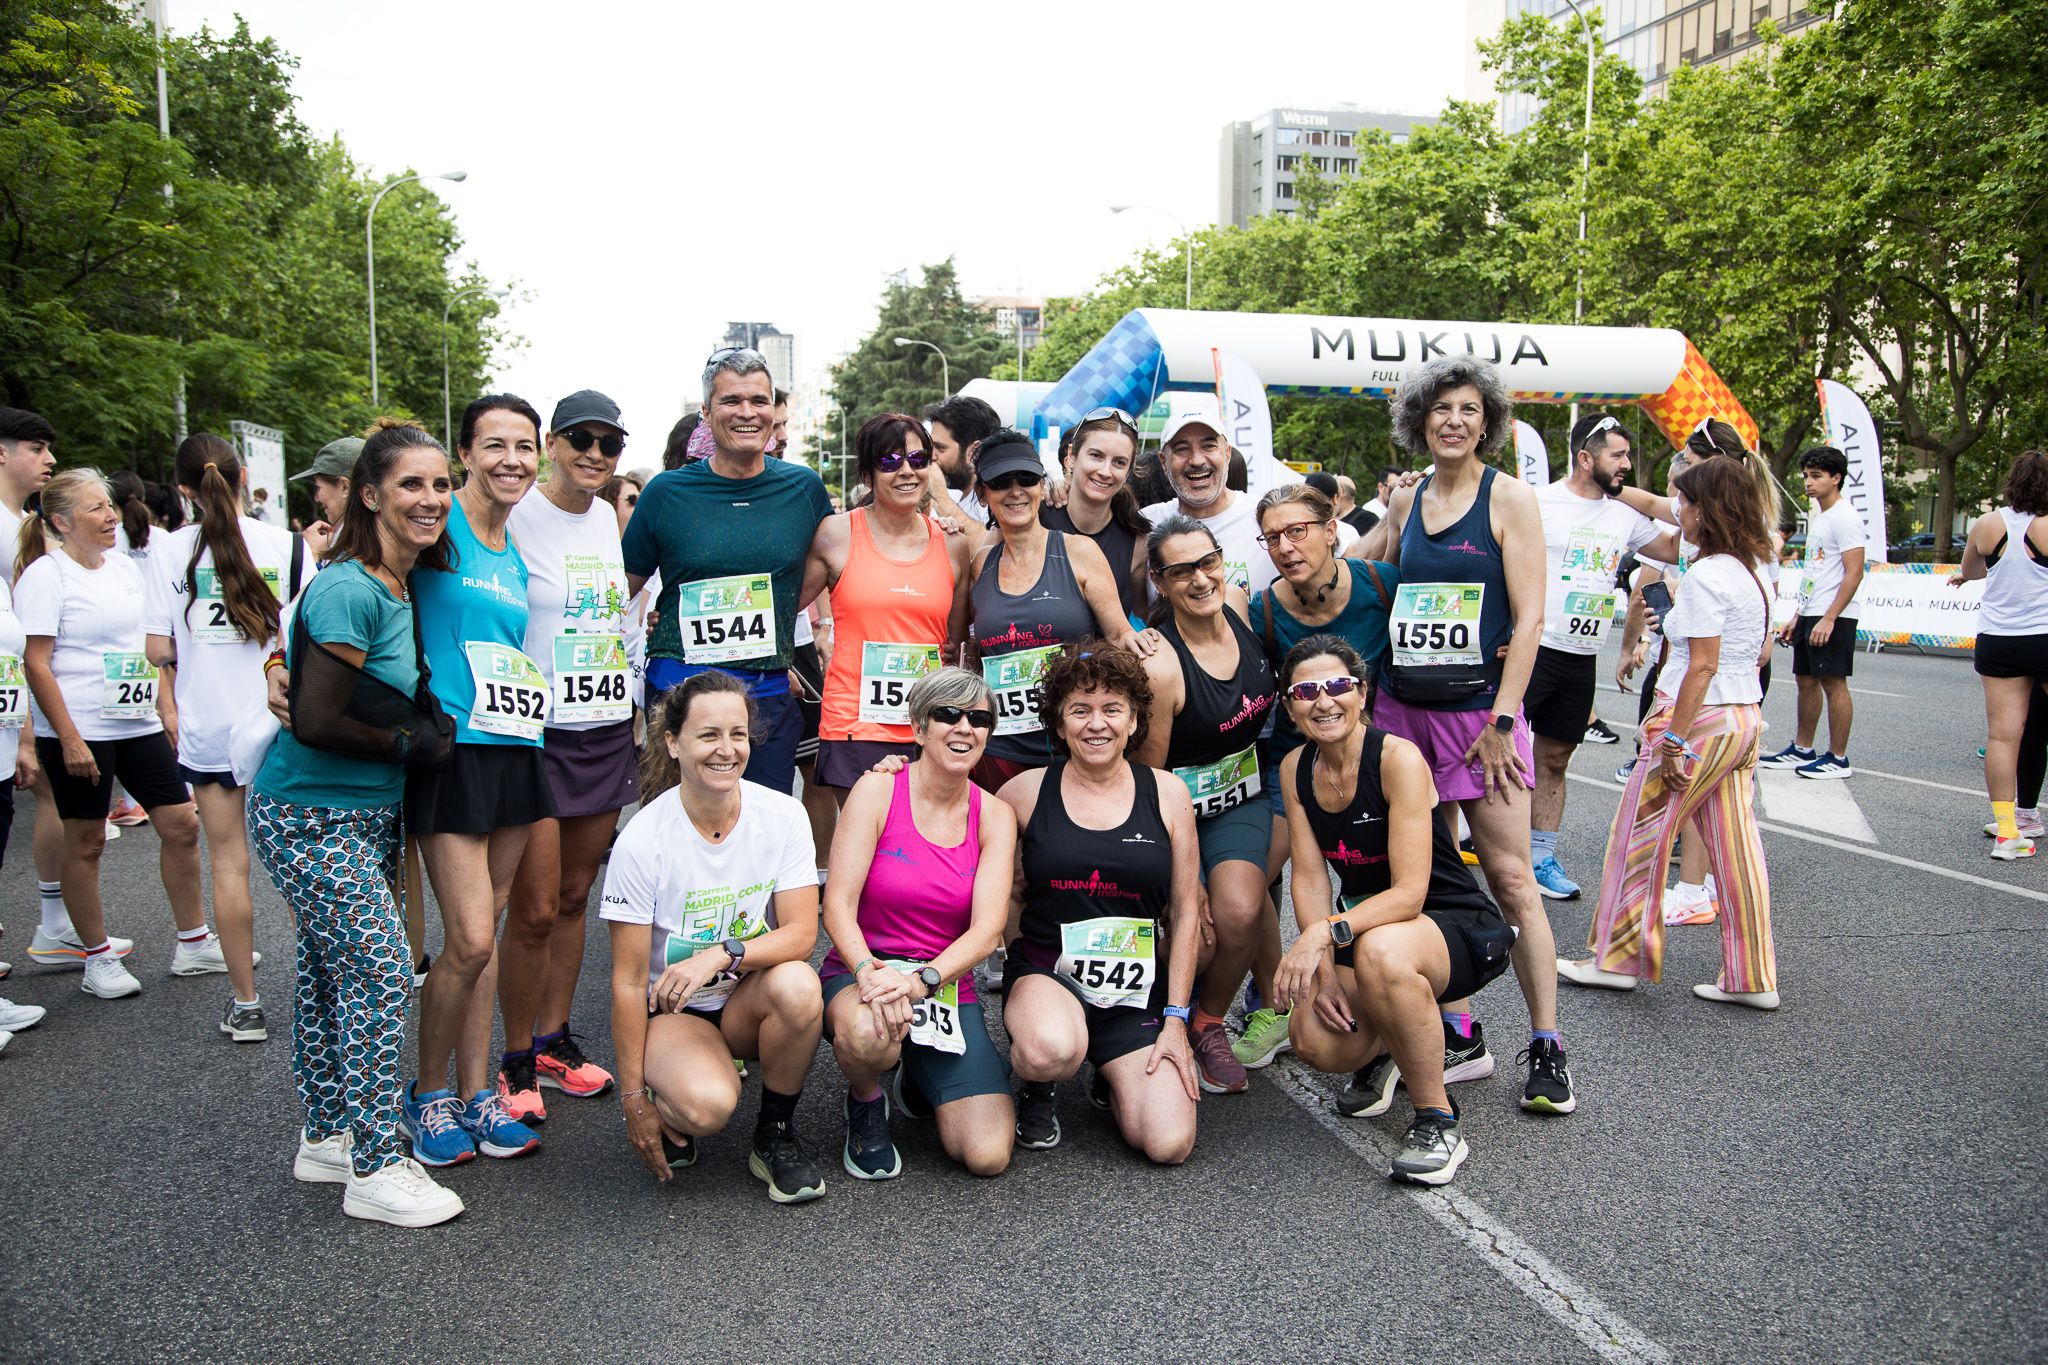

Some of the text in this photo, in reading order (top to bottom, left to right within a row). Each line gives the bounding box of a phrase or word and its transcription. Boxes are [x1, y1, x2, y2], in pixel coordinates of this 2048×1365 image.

[1282, 111, 1329, 126] WESTIN
[1310, 326, 1549, 367] MUKUA
[1371, 370, 1400, 382] FULL
[463, 577, 513, 597] RUNNING
[699, 585, 753, 612] ELA
[1412, 593, 1462, 617] ELA
[1572, 597, 1605, 615] ELA
[1866, 597, 1982, 612] MUKUA MUKUA
[691, 613, 767, 646] 1544
[981, 630, 1034, 649] RUNNING
[1397, 622, 1469, 650] 1550
[1569, 617, 1600, 637] 961
[573, 643, 619, 668] ELA
[881, 652, 930, 675] ELA
[1000, 657, 1047, 685] ELA
[118, 683, 153, 704] 264
[485, 682, 545, 721] 1552
[563, 673, 627, 704] 1548
[997, 688, 1041, 718] 155
[1220, 694, 1265, 733] RUNNING
[1197, 761, 1242, 795] ELA
[1193, 781, 1248, 819] 1551
[1322, 849, 1362, 860] UNNING
[685, 893, 735, 910] MADRID
[738, 883, 762, 899] CON
[1051, 879, 1118, 891] RUNNING
[1098, 889, 1143, 901] mothers
[601, 896, 629, 905] KUA
[1086, 926, 1137, 954] ELA
[1070, 959, 1145, 991] 1542
[912, 998, 954, 1036] 543
